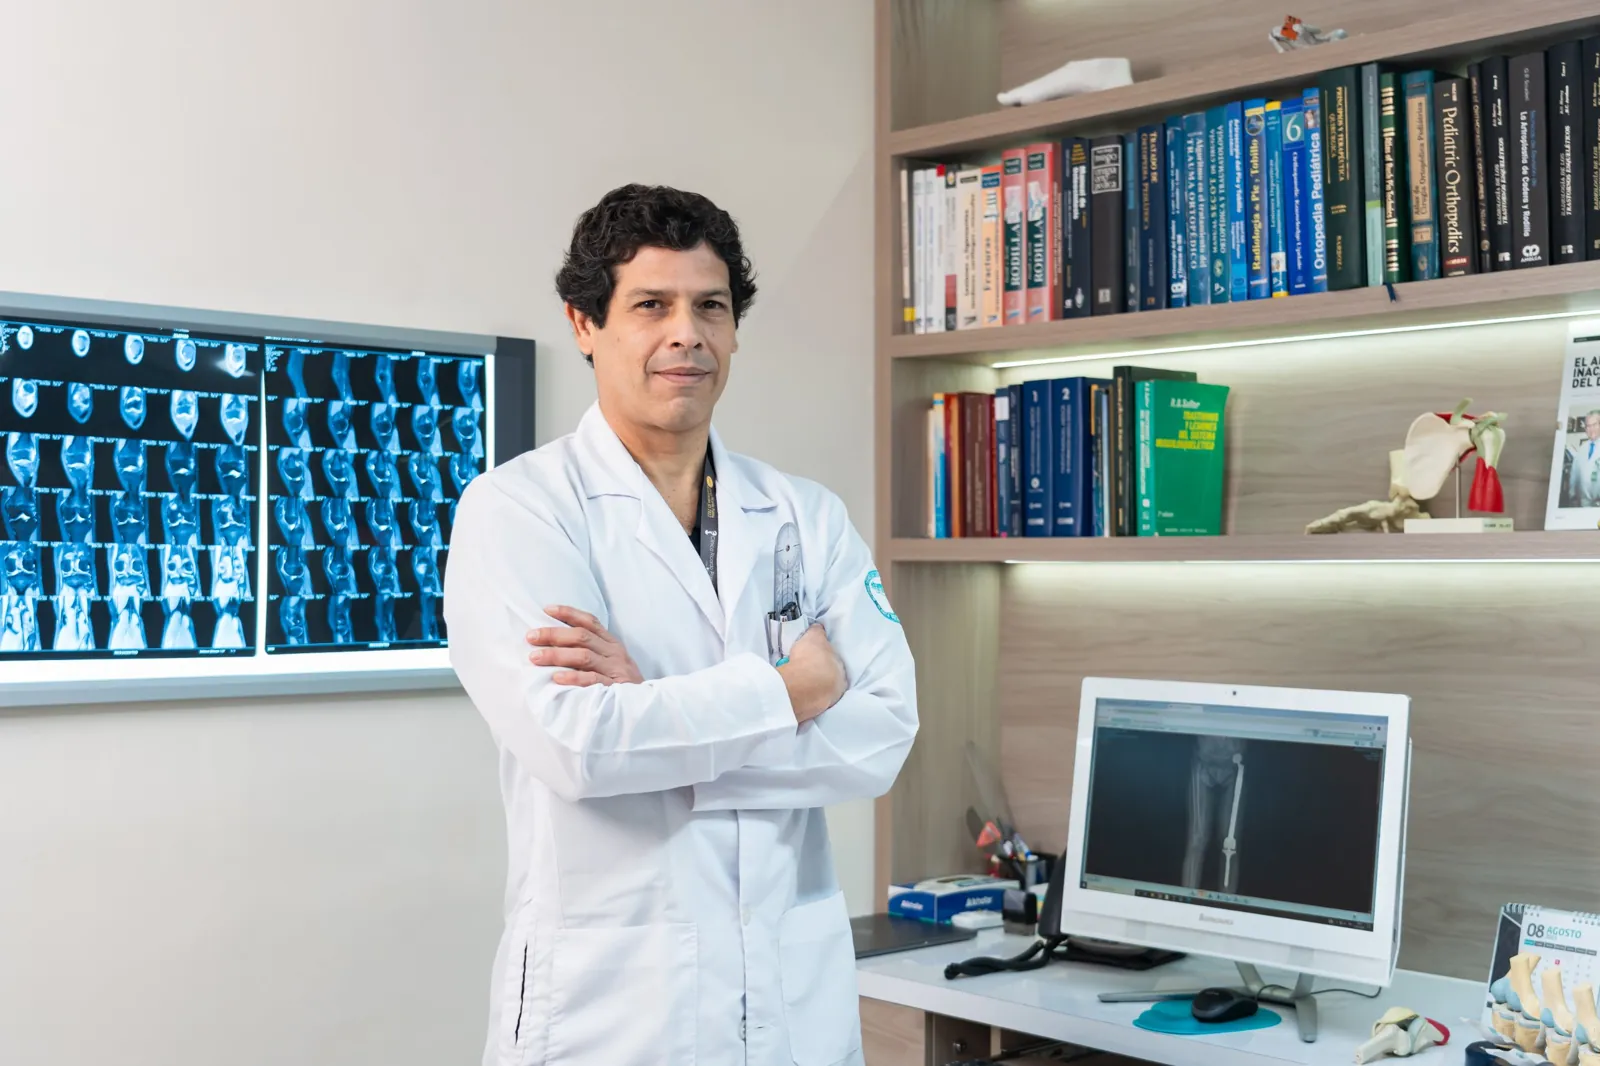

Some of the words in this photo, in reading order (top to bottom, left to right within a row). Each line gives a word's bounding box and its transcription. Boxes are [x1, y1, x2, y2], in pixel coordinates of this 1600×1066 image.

[1336, 87, 1344, 126] PRINCIPIOS
[1416, 102, 1425, 141] Pediátrica
[1520, 111, 1528, 121] La
[1287, 114, 1301, 142] 6
[1384, 137, 1392, 154] Atlas
[1443, 107, 1459, 167] Pediatric
[1520, 122, 1530, 164] Artroplastia
[1187, 138, 1196, 189] TRAUMA
[1195, 139, 1204, 181] Algoritmo
[1216, 125, 1224, 193] TRAUMATOLOGÍA
[1250, 139, 1259, 176] Tobillo
[1309, 132, 1321, 199] Pediátrica
[1417, 142, 1427, 184] Ortopédica
[1498, 137, 1506, 183] ESQUELÉTICOS
[1563, 125, 1571, 172] ESQUELÉTICOS
[1198, 182, 1203, 192] en
[1211, 164, 1216, 174] DE
[1522, 166, 1529, 175] de
[1198, 193, 1206, 202] el
[1209, 177, 1217, 218] SECOT
[1251, 185, 1259, 202] Pie
[1413, 185, 1419, 194] de
[1419, 186, 1428, 215] Cirugía
[1521, 177, 1530, 203] Cadera
[1188, 192, 1198, 269] ORTOPÉDICO
[1198, 203, 1207, 253] tratamiento
[1218, 202, 1227, 254] ORTOPÉDICA
[1444, 169, 1463, 253] Orthopedics
[1523, 211, 1531, 237] Rodilla
[1010, 222, 1021, 286] RODILLA
[1034, 220, 1044, 283] RODILLA
[1252, 214, 1261, 270] Radiología
[1312, 203, 1325, 269] Ortopedia
[983, 237, 992, 291] Fracturas
[1199, 255, 1208, 267] del
[1573, 367, 1600, 377] INAC
[1575, 357, 1587, 367] EL
[1062, 387, 1069, 400] 2
[1572, 378, 1592, 388] DEL
[1527, 923, 1545, 938] 08
[1547, 926, 1582, 938] AGOSTO
